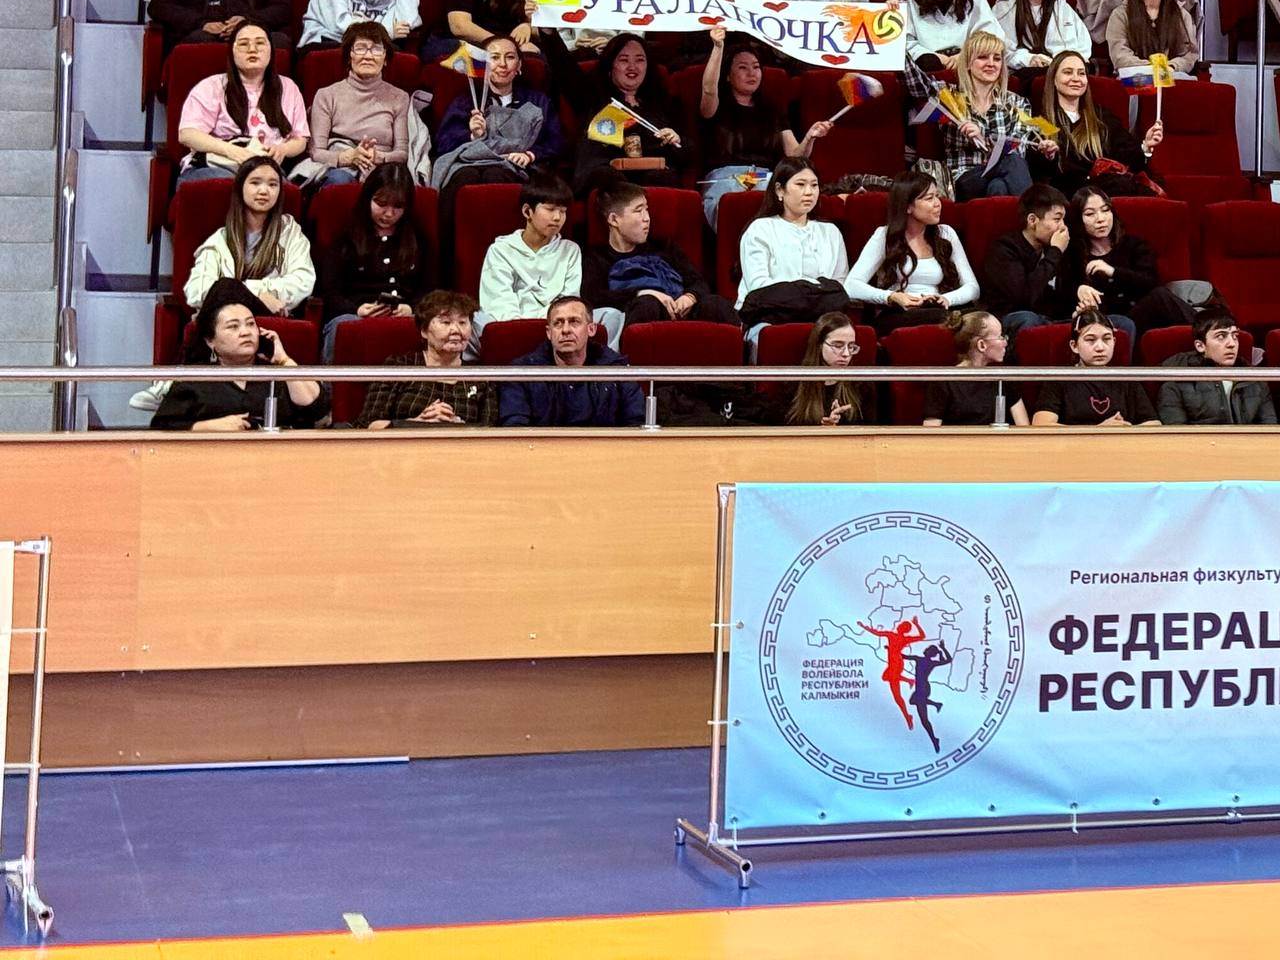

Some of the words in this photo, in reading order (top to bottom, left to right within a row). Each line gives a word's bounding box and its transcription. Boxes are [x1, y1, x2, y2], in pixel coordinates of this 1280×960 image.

[1070, 569, 1188, 584] Региональная
[802, 659, 864, 668] ФЕДЕРАЦИЯ
[802, 669, 864, 678] ВОЛЕЙБОЛА
[801, 680, 869, 689] РЕСПУБЛИКИ
[801, 691, 860, 700] КАЛМЫКИЯ
